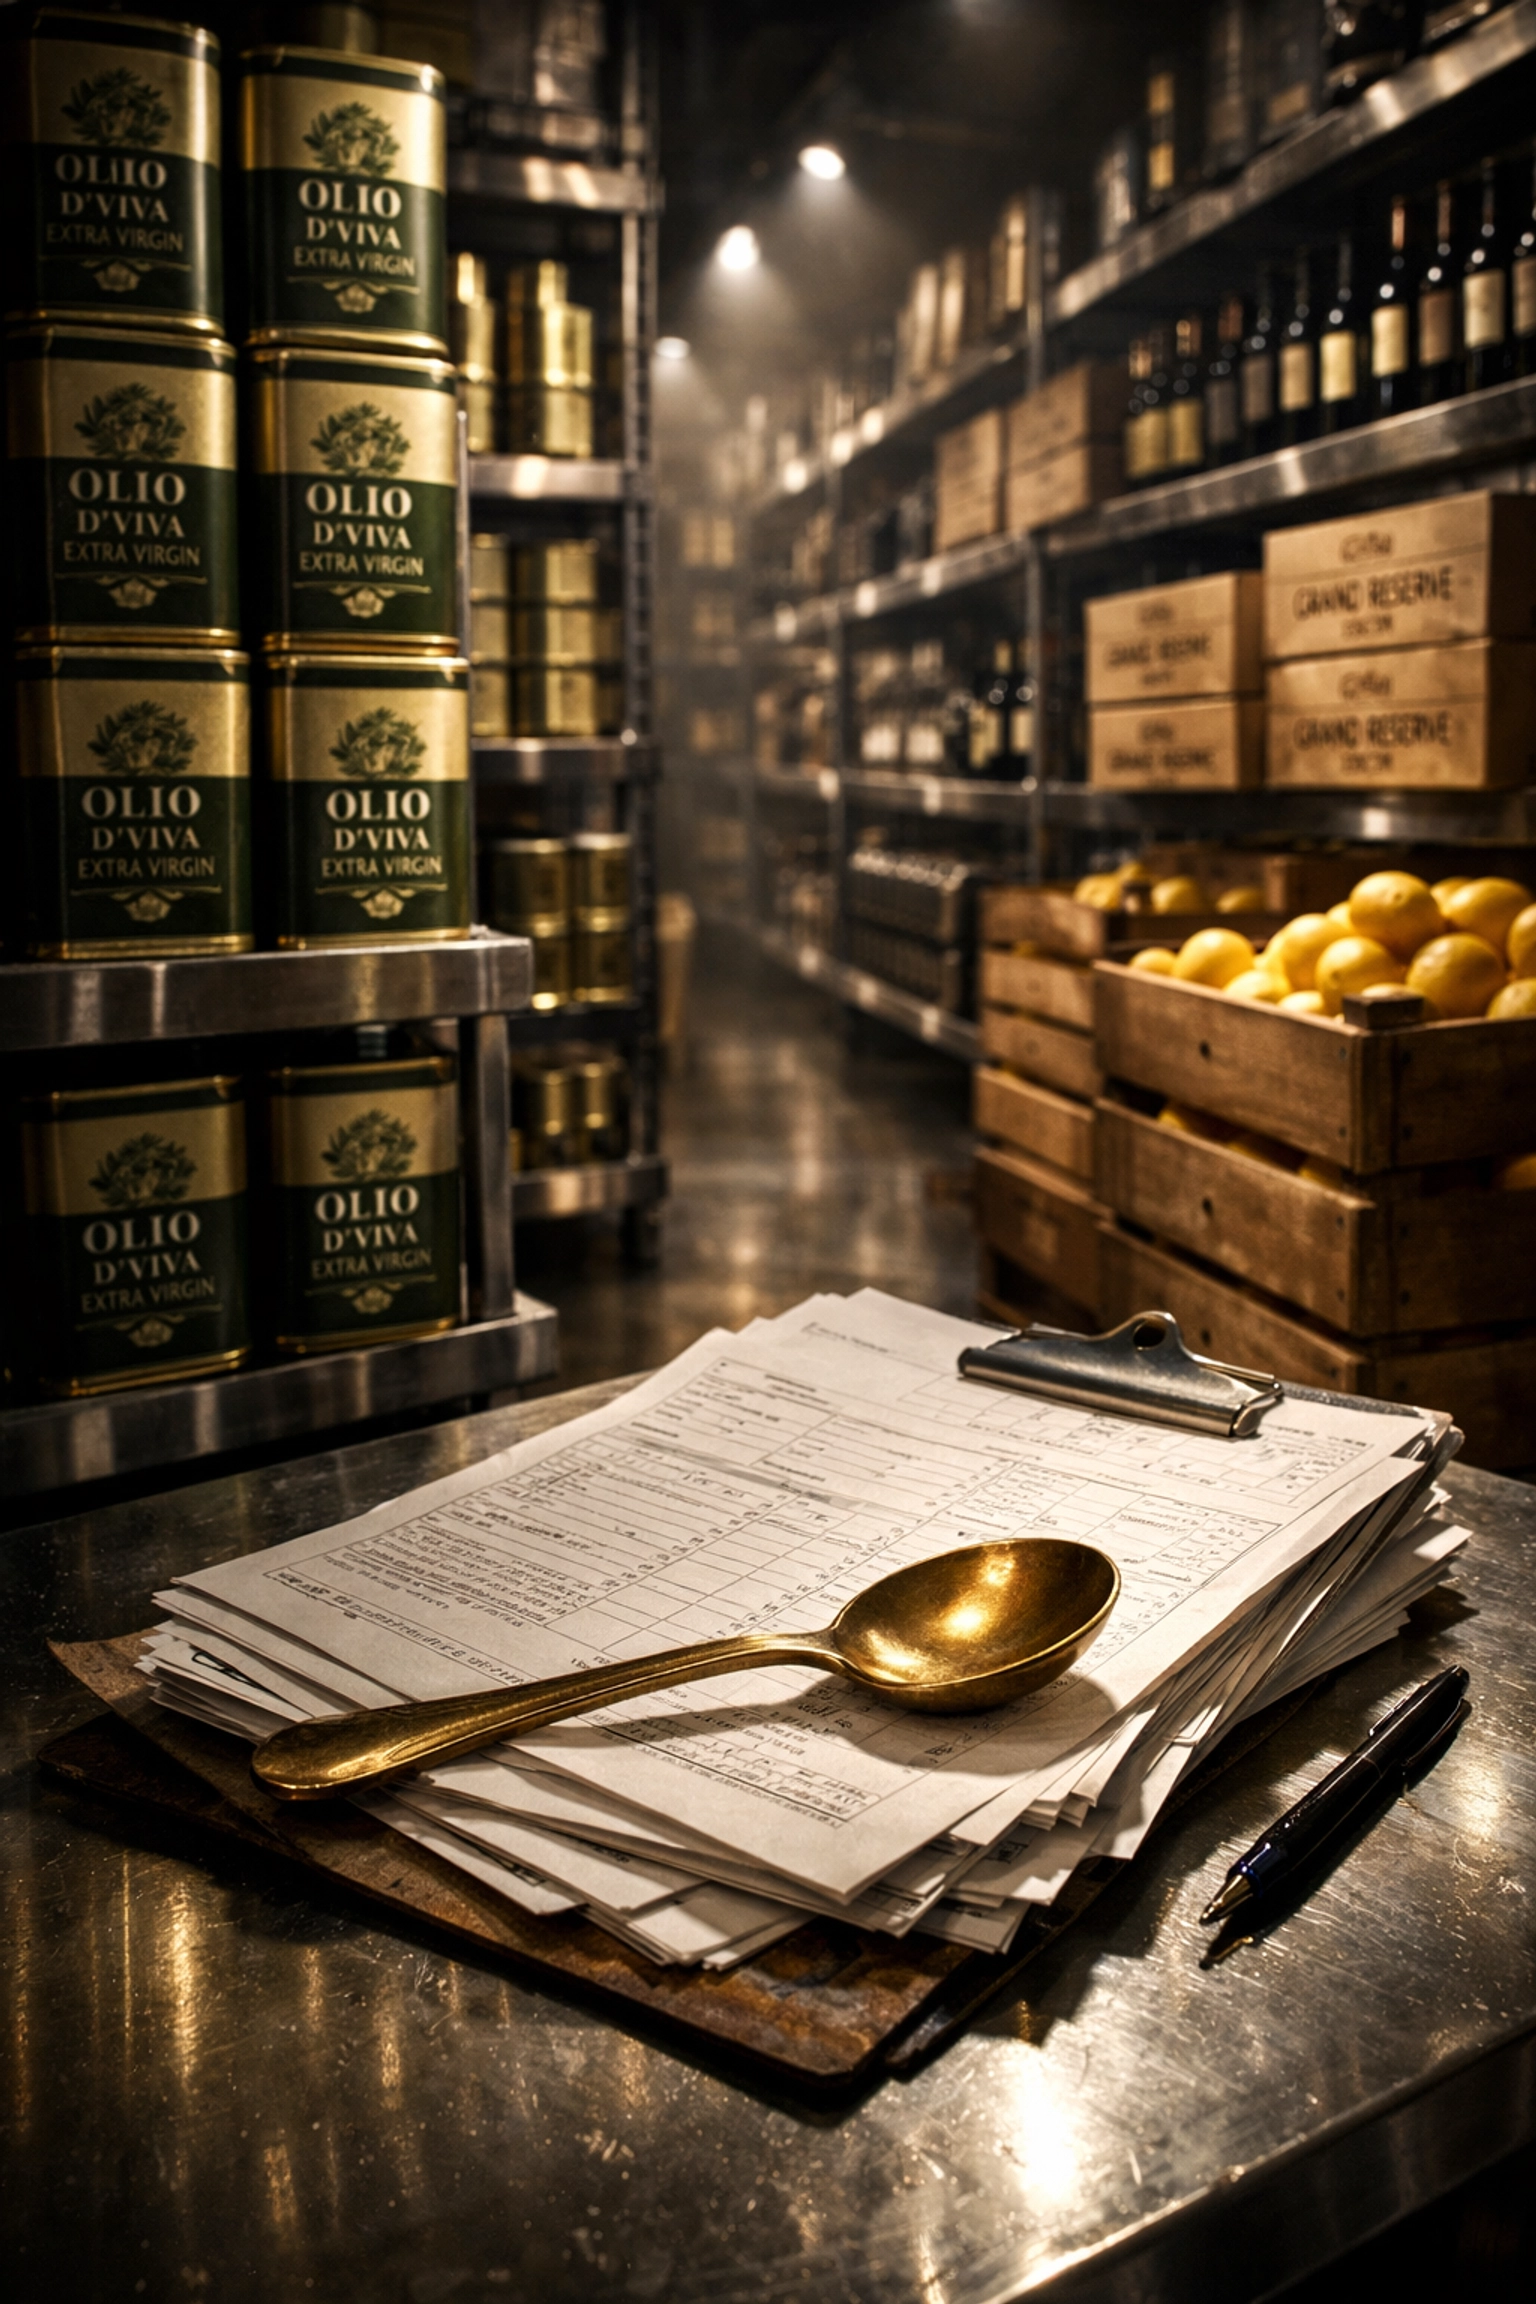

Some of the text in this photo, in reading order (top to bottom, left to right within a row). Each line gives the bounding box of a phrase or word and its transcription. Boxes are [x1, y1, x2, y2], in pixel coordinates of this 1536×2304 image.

[60, 191, 169, 223] D'VIVA
[299, 178, 402, 219] OLIO
[46, 223, 184, 252] EXTRA VIRGIN
[306, 217, 402, 250] D'VIVA
[293, 246, 416, 277] EXTRA VIRGIN
[68, 467, 186, 505] OLIO
[306, 482, 413, 520] OLIO
[77, 509, 185, 538] D'VIVA
[313, 521, 412, 550] D'VIVA
[63, 541, 201, 567] EXTRA VIRGIN
[301, 551, 424, 577] EXTRA VIRGIN
[82, 785, 201, 819] OLIO
[325, 788, 431, 822] OLIO
[92, 826, 200, 851] D'VIVA
[334, 826, 430, 852] D'VIVA
[78, 855, 216, 880] EXTRA VIRGIN
[321, 855, 443, 878] EXTRA VIRGIN
[315, 1184, 420, 1225] OLIO
[82, 1210, 201, 1255] OLIO
[323, 1221, 419, 1254] D'VIVA
[93, 1250, 201, 1287] D'VIVA
[311, 1248, 433, 1280] EXTRA VIRGIN
[81, 1277, 216, 1315] EXTRA VIRGIN
